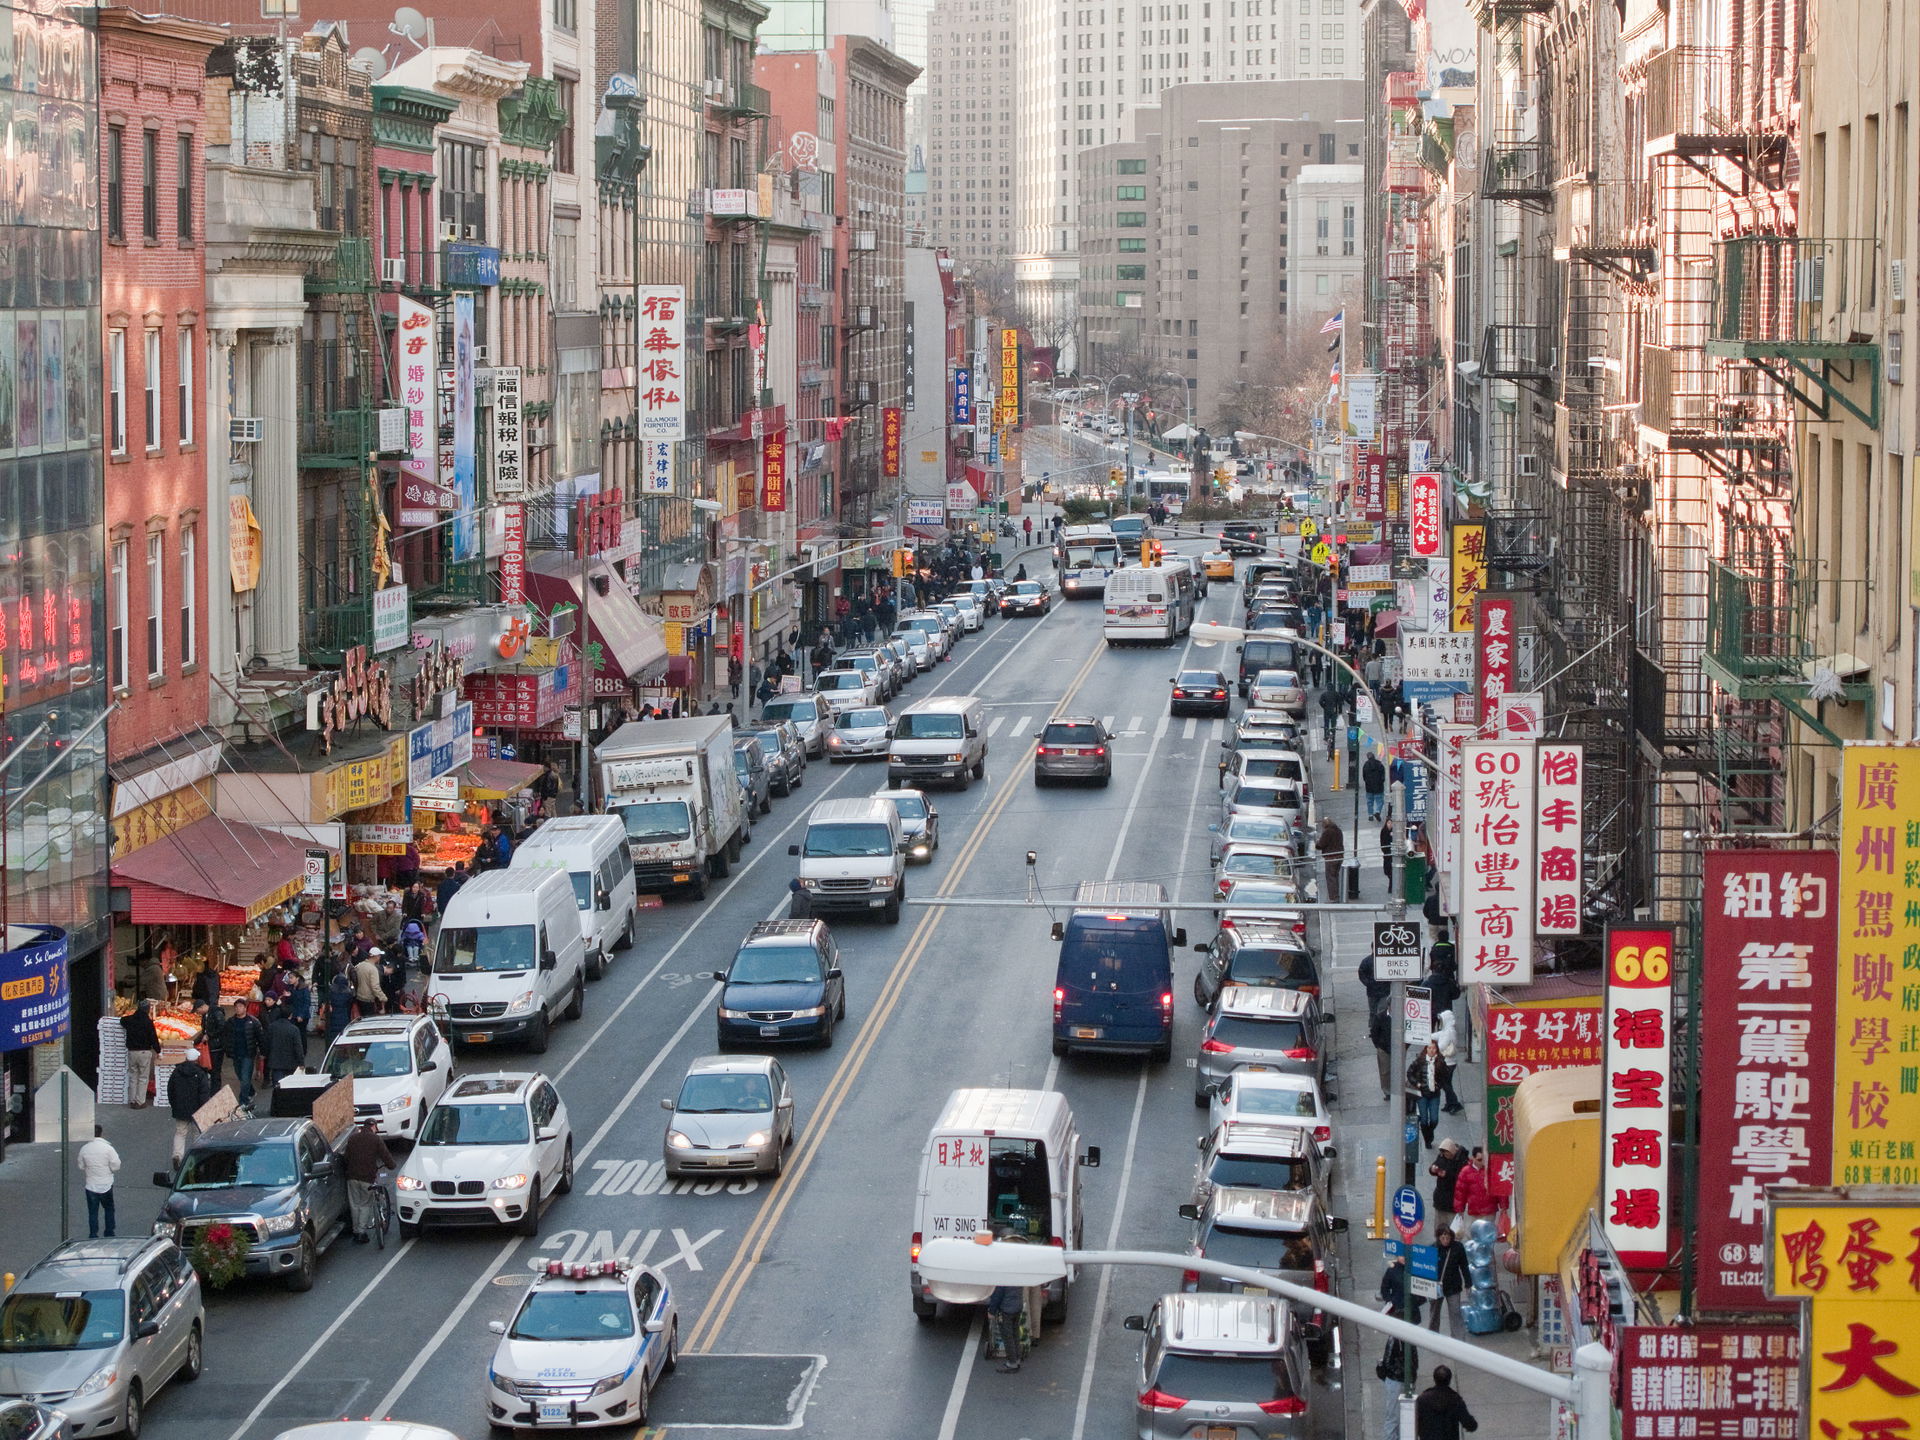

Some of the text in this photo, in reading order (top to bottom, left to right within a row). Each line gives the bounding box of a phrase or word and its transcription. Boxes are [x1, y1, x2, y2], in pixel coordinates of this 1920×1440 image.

[642, 296, 680, 411] 福華傢俬
[594, 678, 623, 692] 888
[1723, 872, 1827, 918] 紐約
[1397, 947, 1418, 955] LANE
[1849, 761, 1900, 1130] 廣州駕駛學校
[1388, 969, 1408, 977] ONLY
[1615, 946, 1669, 982] 66
[1496, 1065, 1523, 1080] 62
[1849, 1140, 1915, 1161] 東百老匯
[933, 1217, 950, 1232] YAT
[955, 1218, 976, 1232] SING
[1386, 1241, 1397, 1253] M9
[1782, 1218, 1920, 1293] 鴨蛋
[542, 1407, 562, 1417] 5122
[1635, 1415, 1799, 1439] 逢星期二三四五出
